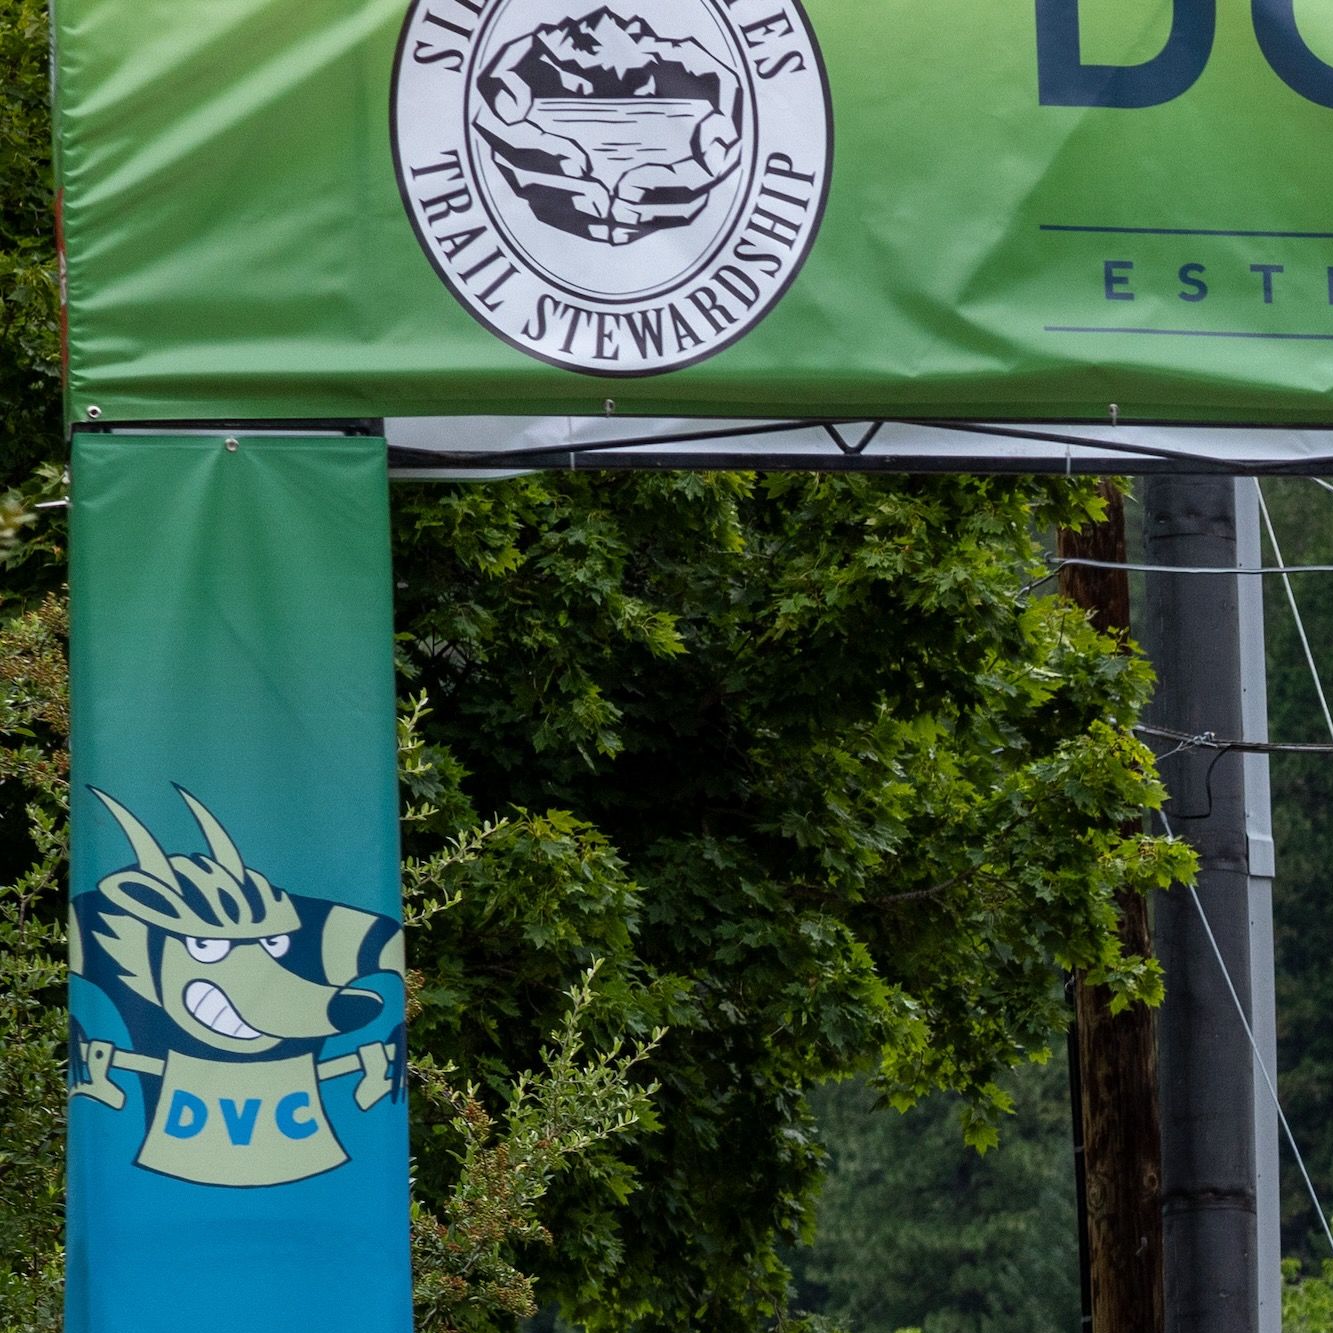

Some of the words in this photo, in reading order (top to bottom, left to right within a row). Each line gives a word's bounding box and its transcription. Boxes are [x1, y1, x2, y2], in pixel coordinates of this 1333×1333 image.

[411, 149, 520, 313] TRAIL
[520, 151, 817, 361] STEWARDSHIP
[164, 1089, 319, 1146] DVC
